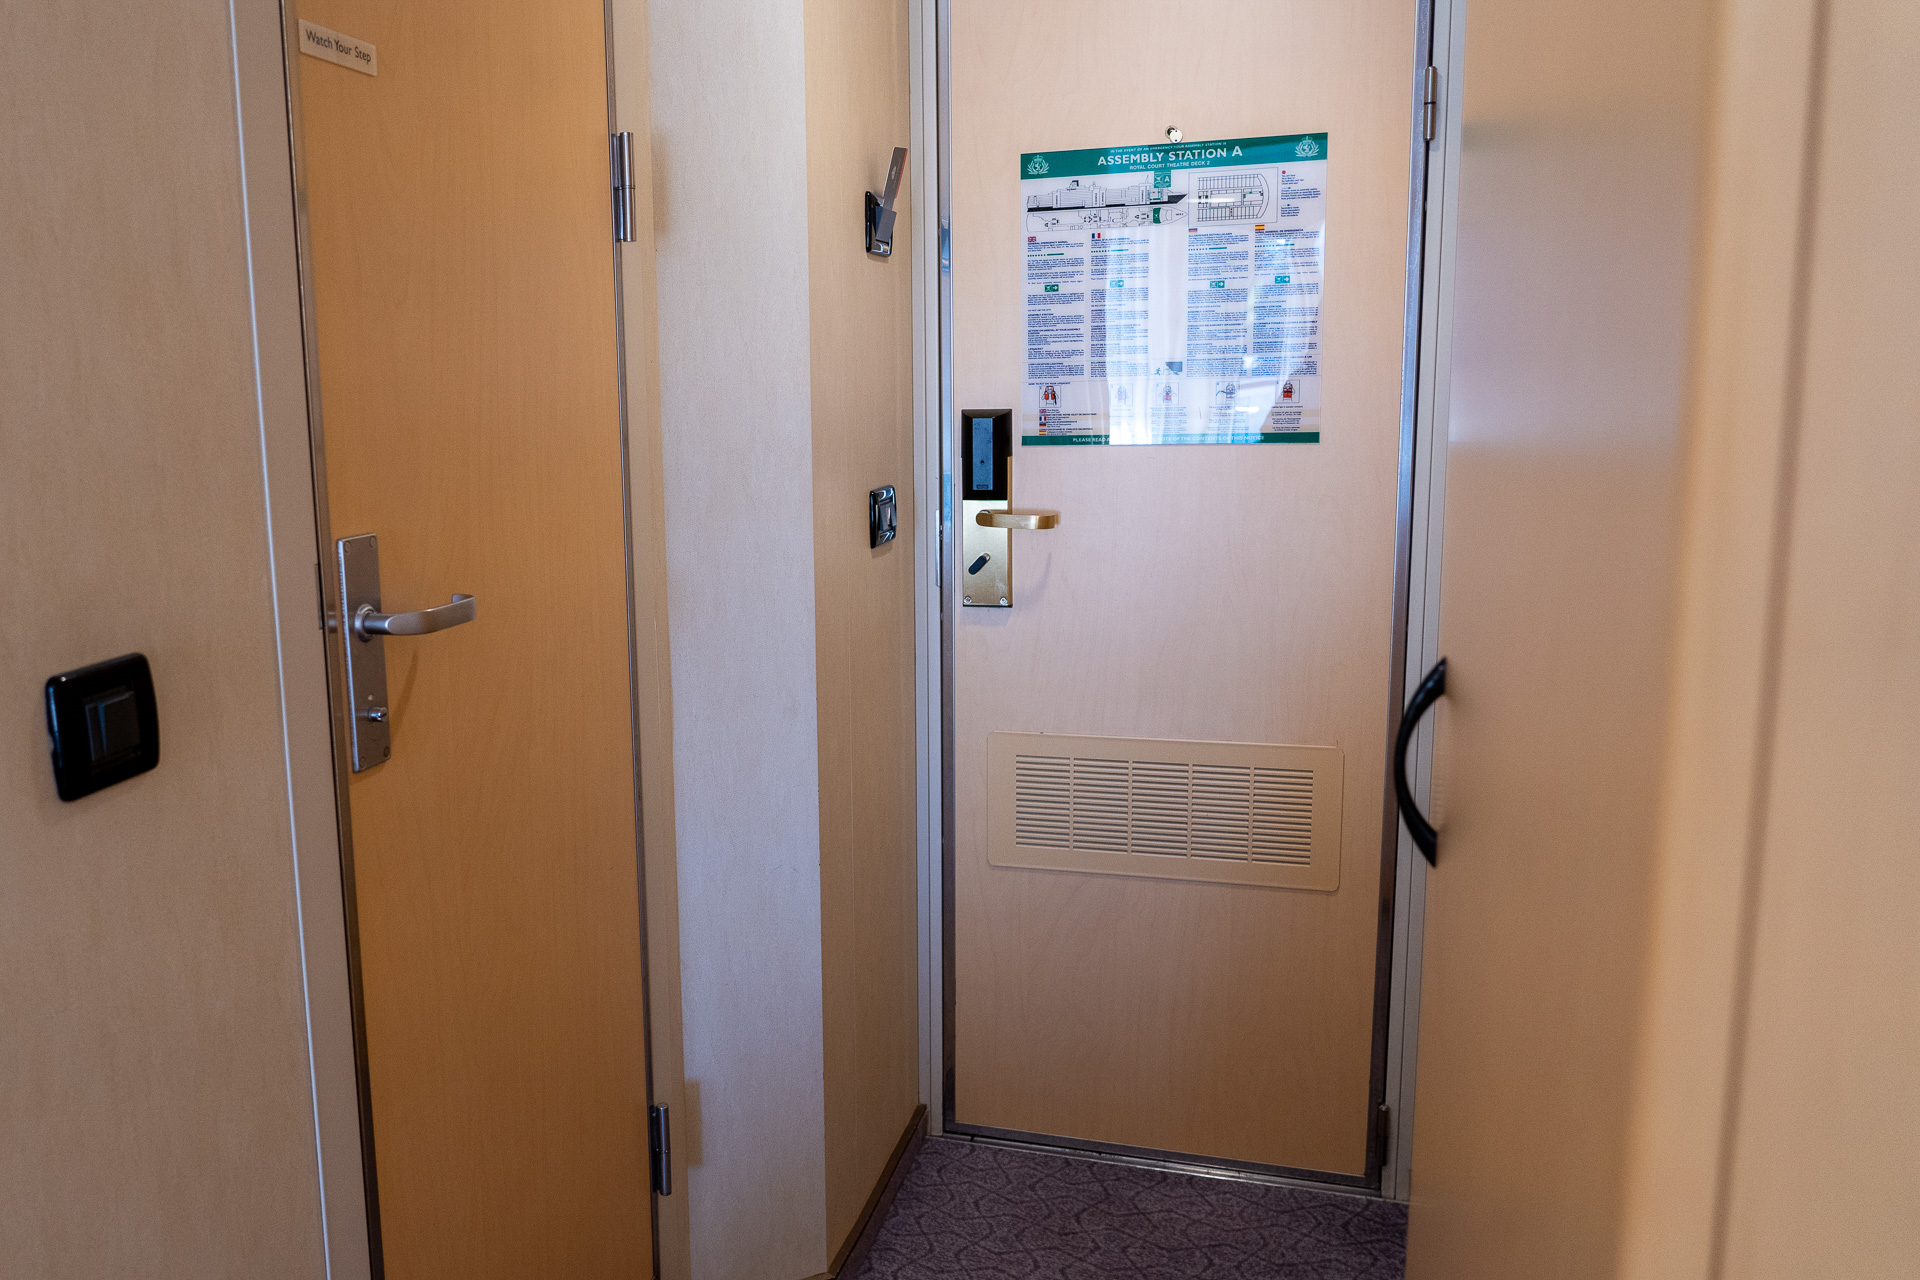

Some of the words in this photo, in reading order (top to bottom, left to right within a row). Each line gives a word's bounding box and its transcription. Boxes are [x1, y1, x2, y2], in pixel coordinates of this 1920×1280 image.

[306, 29, 333, 49] Watch
[334, 39, 352, 56] Your
[354, 46, 372, 65] Step
[1097, 152, 1165, 166] ASSEMBLY
[1168, 148, 1227, 161] STATION
[1232, 145, 1243, 157] A
